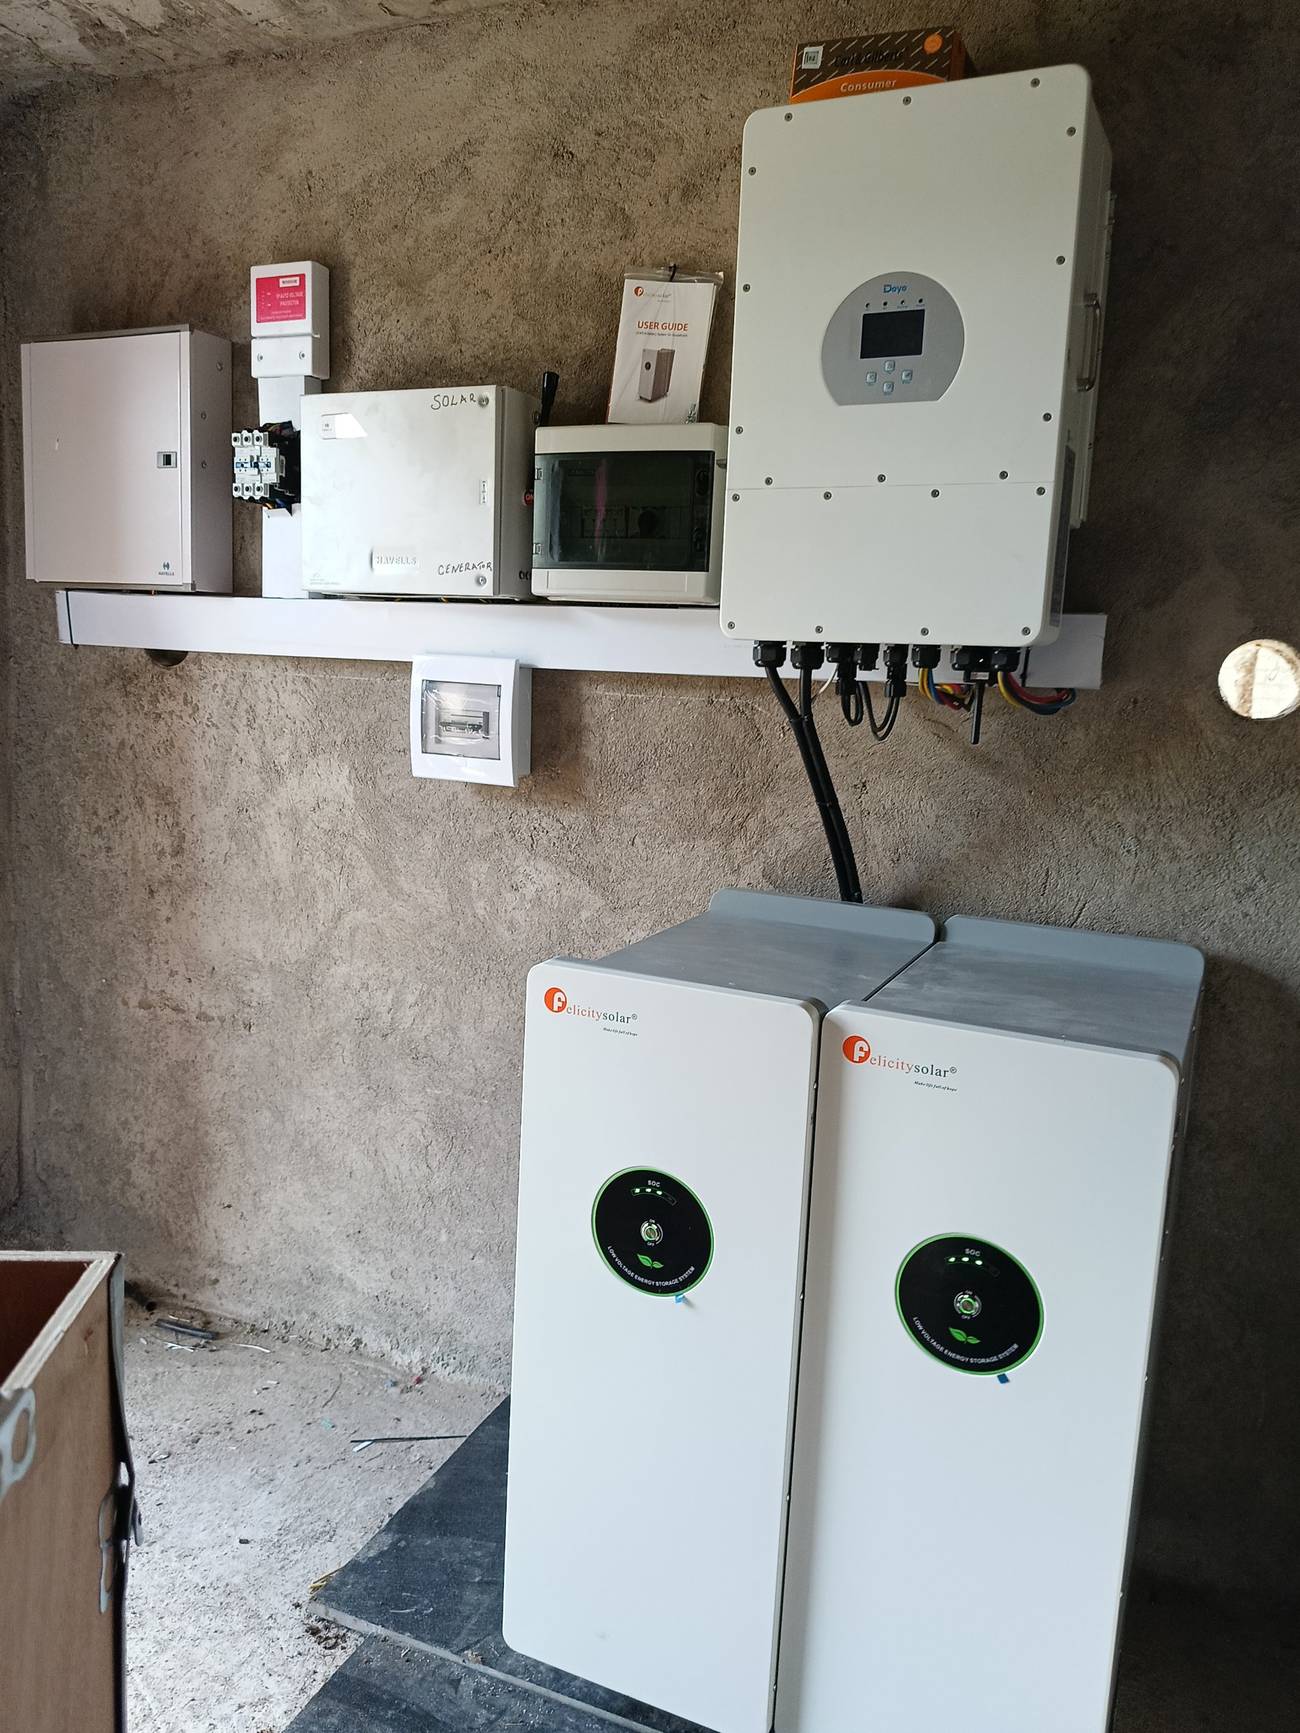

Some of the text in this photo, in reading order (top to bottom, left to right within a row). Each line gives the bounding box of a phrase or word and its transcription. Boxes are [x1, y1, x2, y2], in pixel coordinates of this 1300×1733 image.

[840, 79, 897, 93] Consumer
[637, 320, 689, 332] USER GUIDE
[431, 393, 477, 410] SOLAR
[647, 1180, 661, 1188] SOC
[965, 1248, 981, 1257] SOC
[607, 1245, 696, 1287] LOW VOLTAGE ENERGY STORAGE SYSTEM
[912, 1316, 1019, 1364] LOW VOLTAGE ENERGY STORAGE SYSTEM
